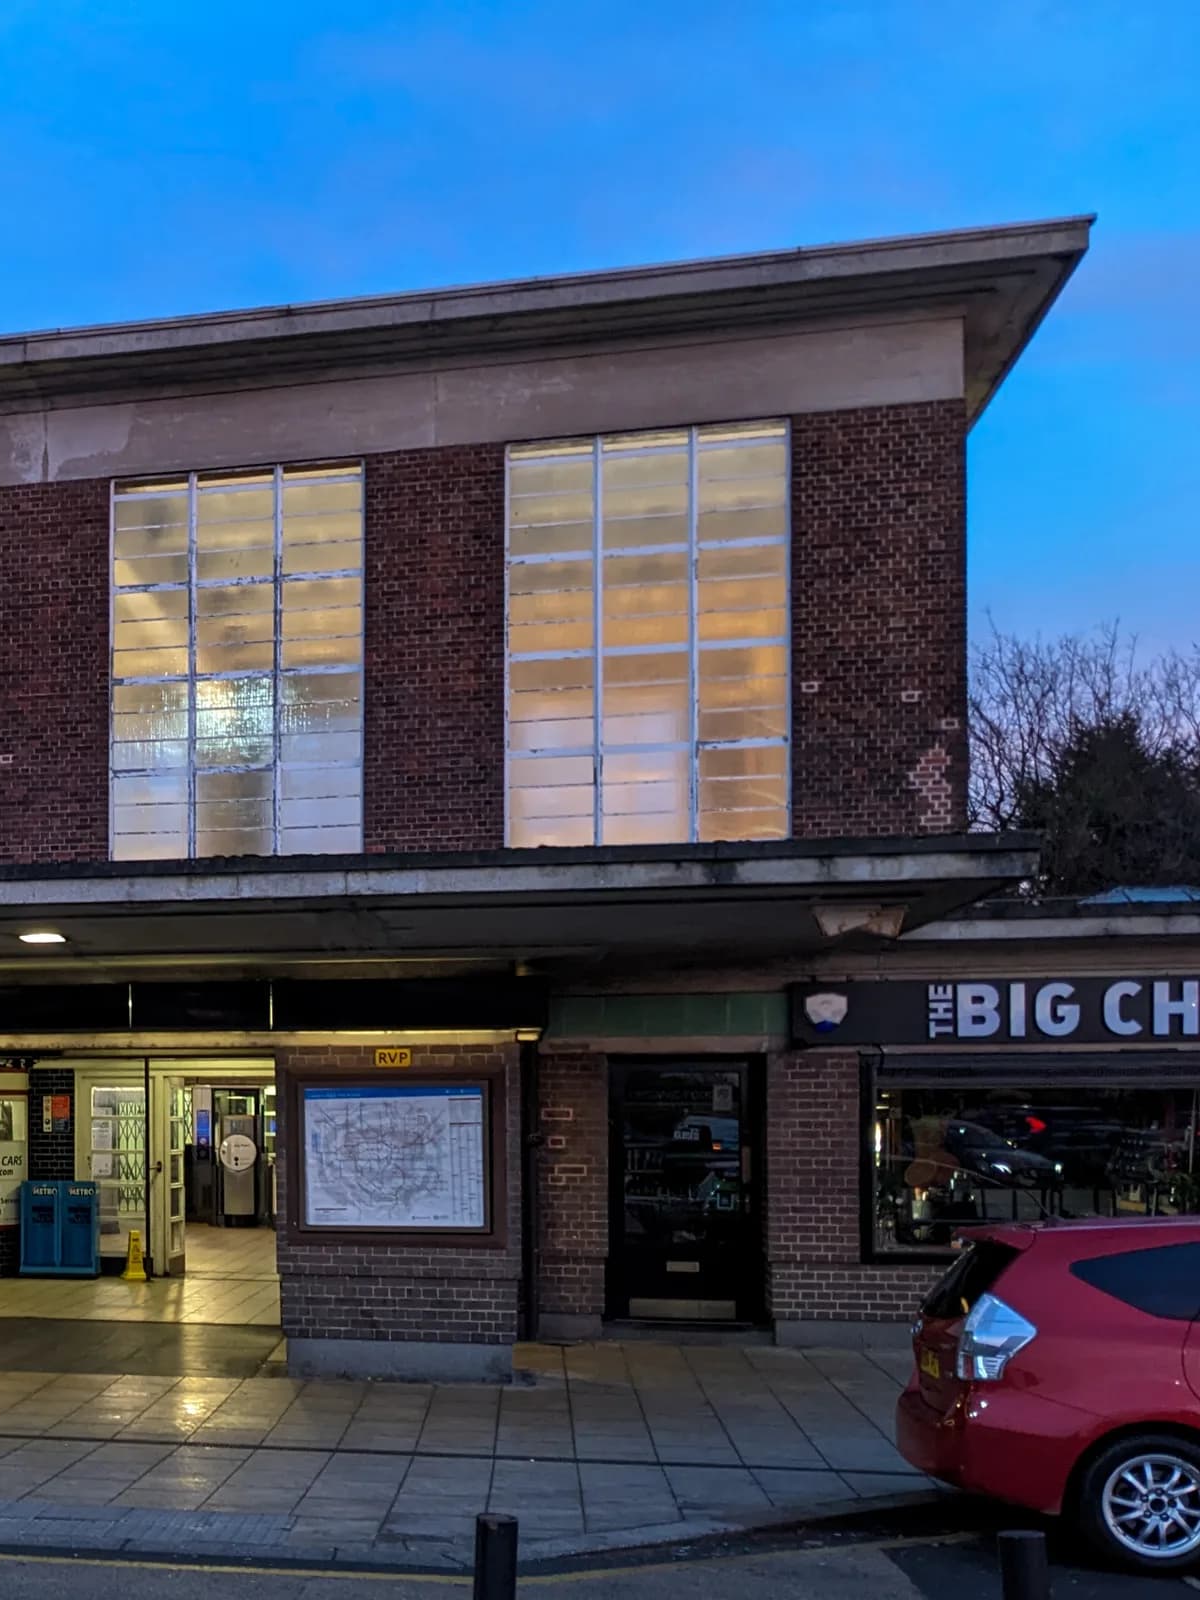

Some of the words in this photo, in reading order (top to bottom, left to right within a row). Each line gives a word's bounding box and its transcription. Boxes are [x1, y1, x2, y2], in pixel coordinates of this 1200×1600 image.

[928, 983, 953, 1039] THE
[957, 982, 1081, 1037] BIG
[378, 1052, 408, 1064] RVP
[1, 1155, 22, 1166] CARS
